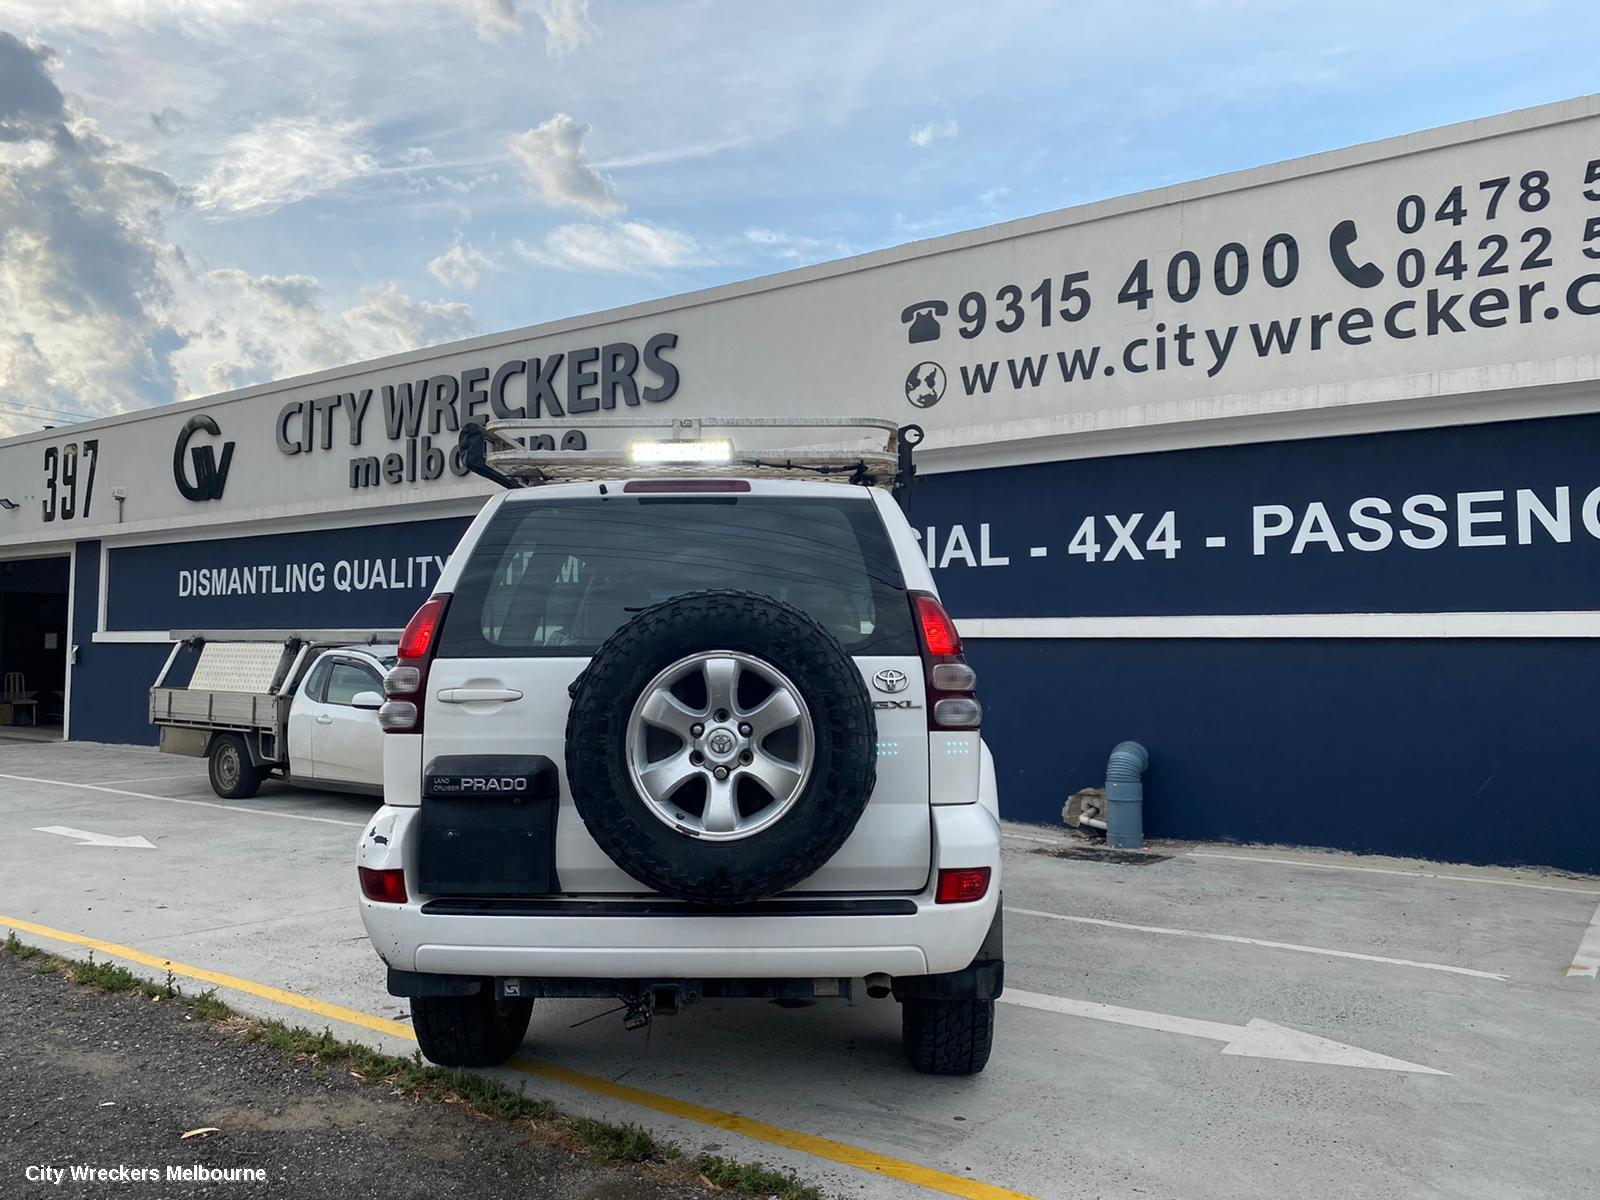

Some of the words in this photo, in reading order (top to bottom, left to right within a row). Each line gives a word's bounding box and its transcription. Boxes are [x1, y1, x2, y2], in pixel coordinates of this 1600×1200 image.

[1396, 170, 1551, 234] 0478
[957, 270, 1091, 339] 9315
[1117, 232, 1300, 310] 4000
[1396, 226, 1553, 288] 0422
[276, 388, 373, 455] CITY
[381, 332, 680, 441] WRECKERS
[41, 439, 99, 522] 397
[911, 523, 1010, 569] IAL
[1067, 511, 1182, 563] 4X4
[178, 562, 326, 597] DISMANTLING
[460, 777, 527, 791] PRADO
